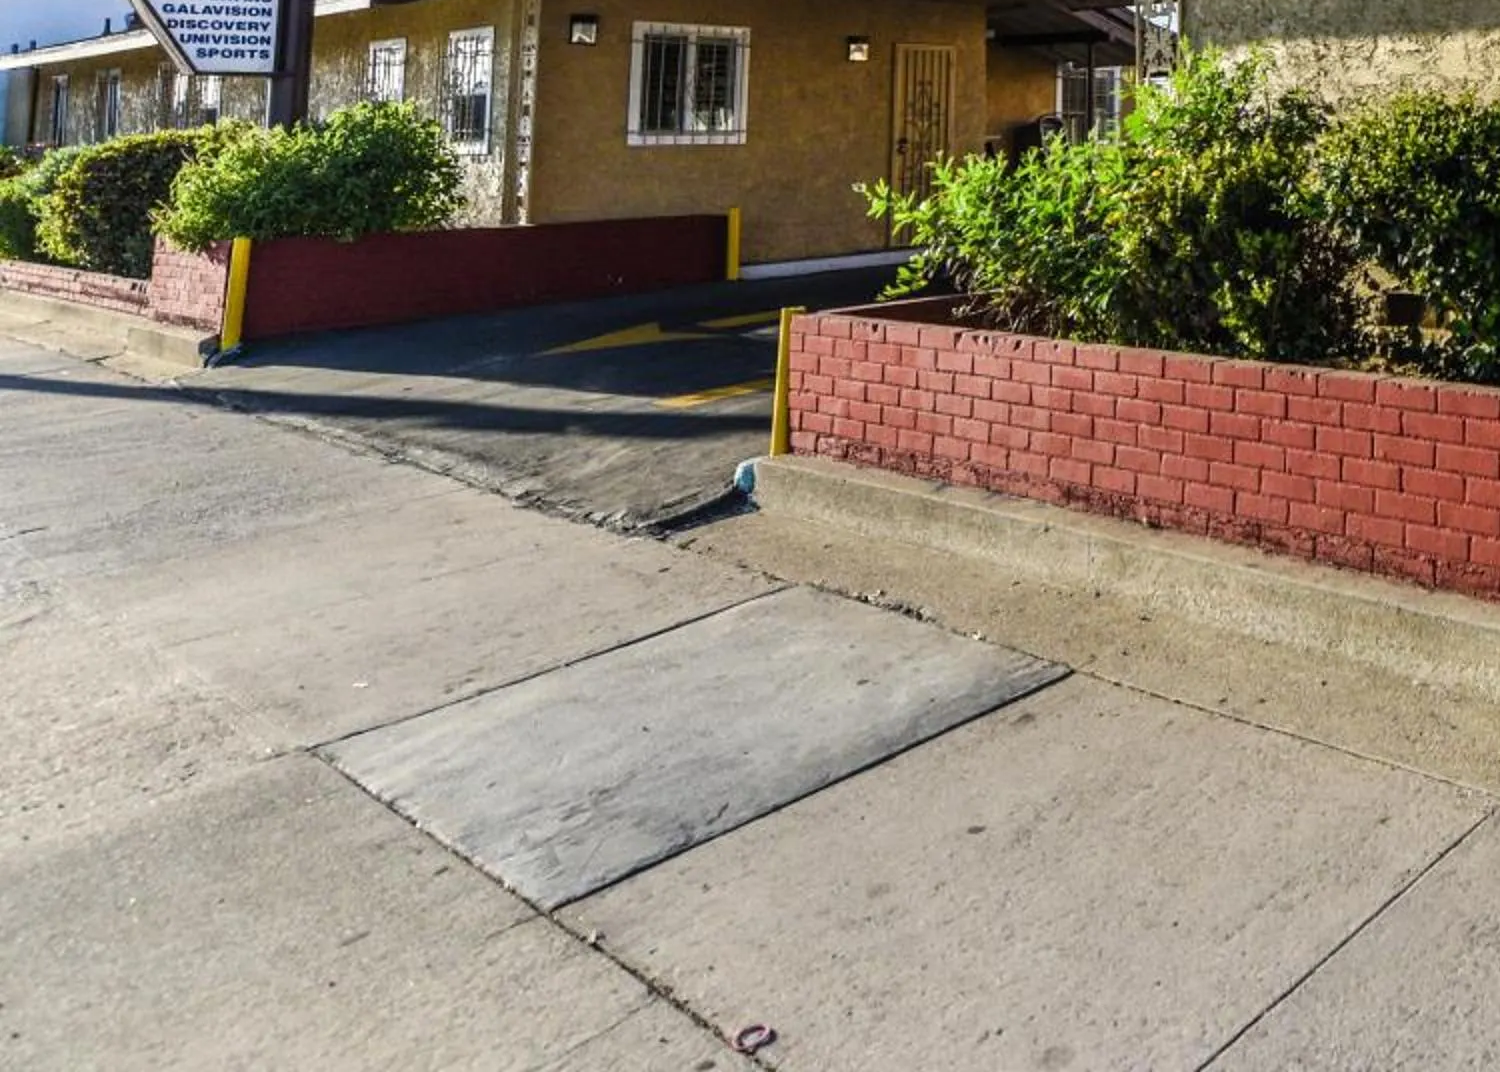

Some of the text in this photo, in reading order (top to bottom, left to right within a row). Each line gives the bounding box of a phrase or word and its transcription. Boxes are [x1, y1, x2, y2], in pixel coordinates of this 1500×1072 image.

[162, 4, 272, 16] GALAVISION
[167, 20, 271, 31] DISCOVERY
[180, 34, 271, 45] UNIVISION
[196, 48, 269, 59] SPORTS
